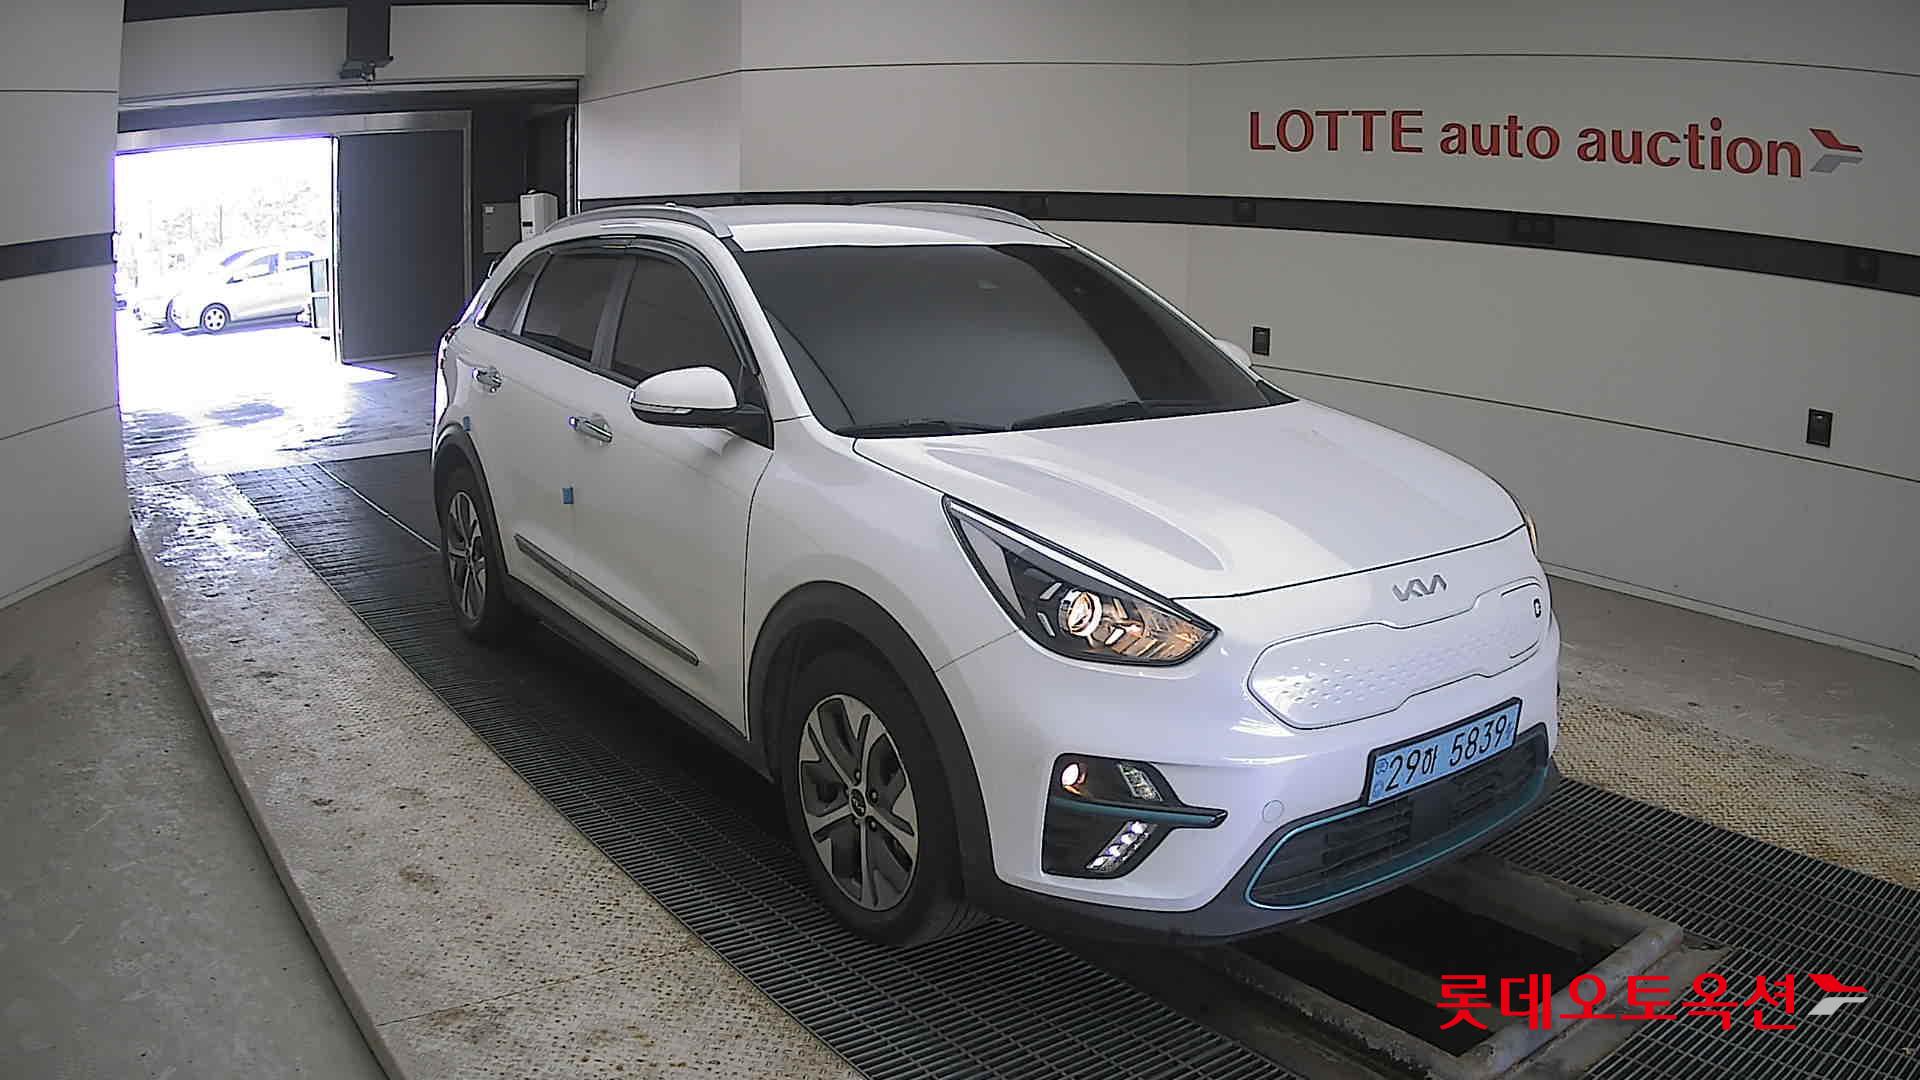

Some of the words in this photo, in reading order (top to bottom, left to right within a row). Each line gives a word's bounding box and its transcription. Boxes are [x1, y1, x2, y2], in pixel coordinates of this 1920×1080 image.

[1250, 109, 1423, 153] LOTTE
[1440, 114, 1560, 160] auto
[1576, 116, 1802, 178] auction
[1392, 574, 1447, 601] KIA
[1385, 744, 1440, 792] 29하
[1449, 714, 1507, 767] 5839
